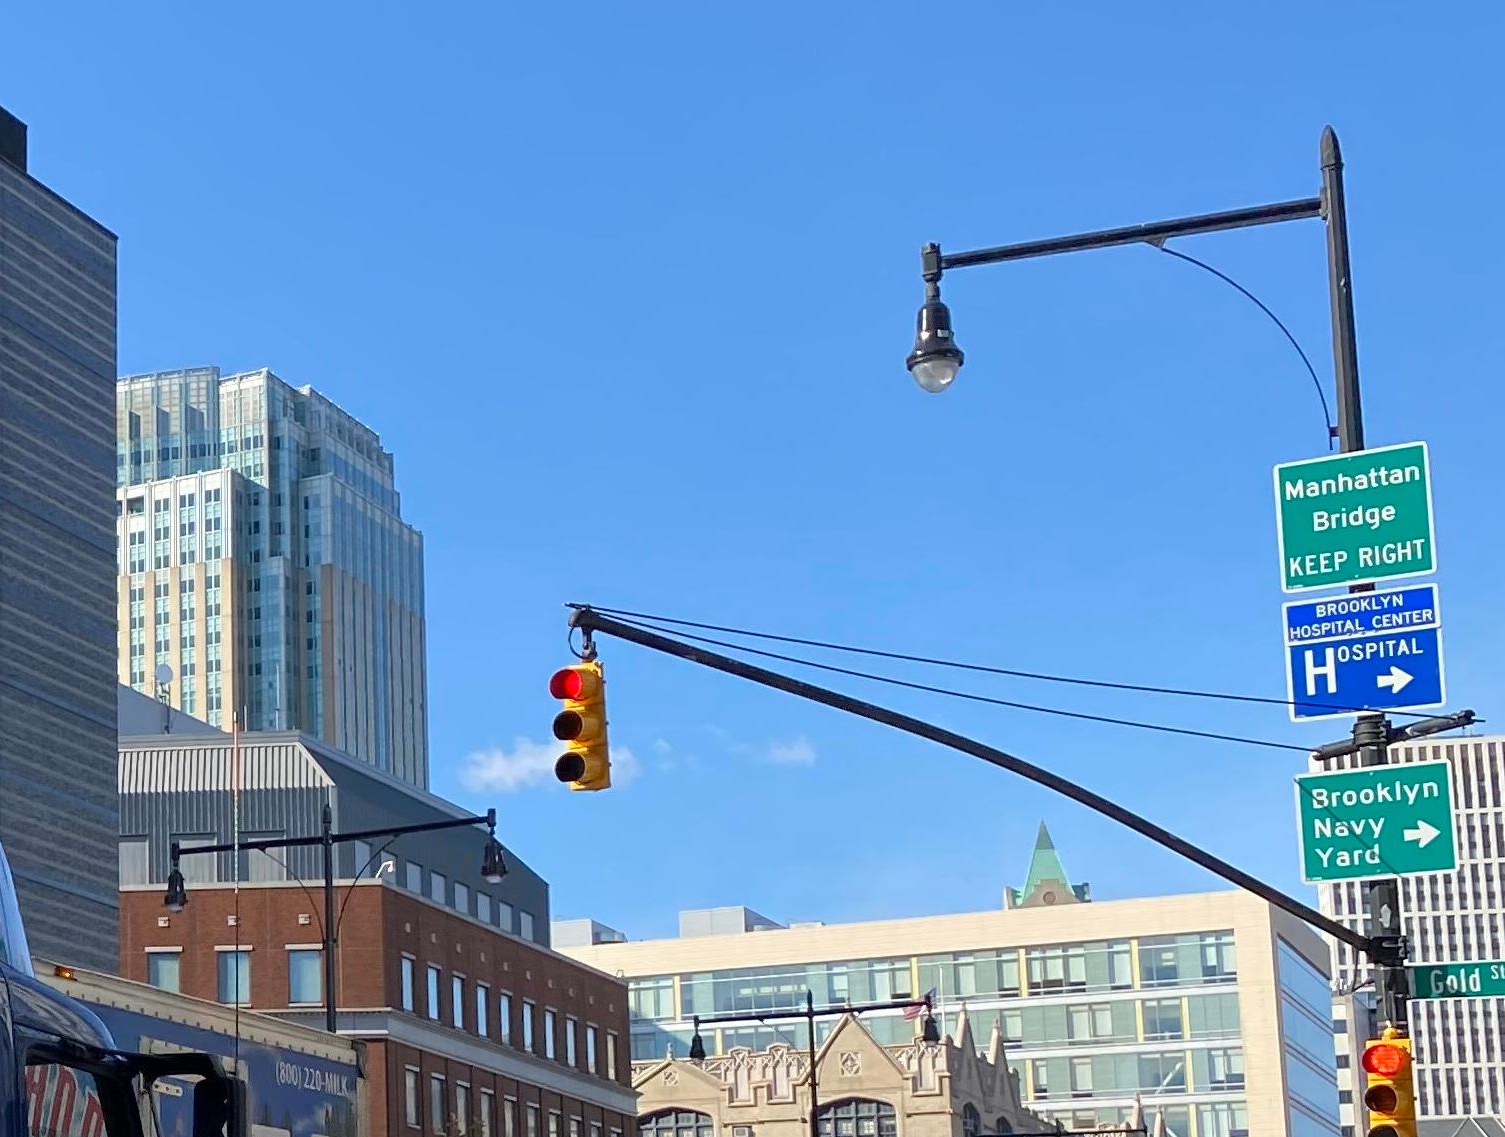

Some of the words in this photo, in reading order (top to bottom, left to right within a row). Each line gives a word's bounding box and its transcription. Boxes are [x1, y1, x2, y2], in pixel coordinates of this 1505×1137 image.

[1284, 465, 1420, 500] Manhattan
[1312, 505, 1396, 532] Bridge
[1289, 550, 1348, 578] KEEP
[1358, 538, 1425, 568] RIGHT
[1315, 594, 1404, 618] BROOKLYN
[1289, 618, 1365, 640] HOSPITAL
[1372, 609, 1434, 629] CENTER
[1311, 781, 1439, 809] Brooklyn
[1314, 817, 1386, 839] Navy
[1315, 843, 1381, 868] Yard
[1430, 967, 1482, 995] Gold
[275, 1060, 302, 1090] (800)
[303, 1066, 348, 1096] 220-MILK
